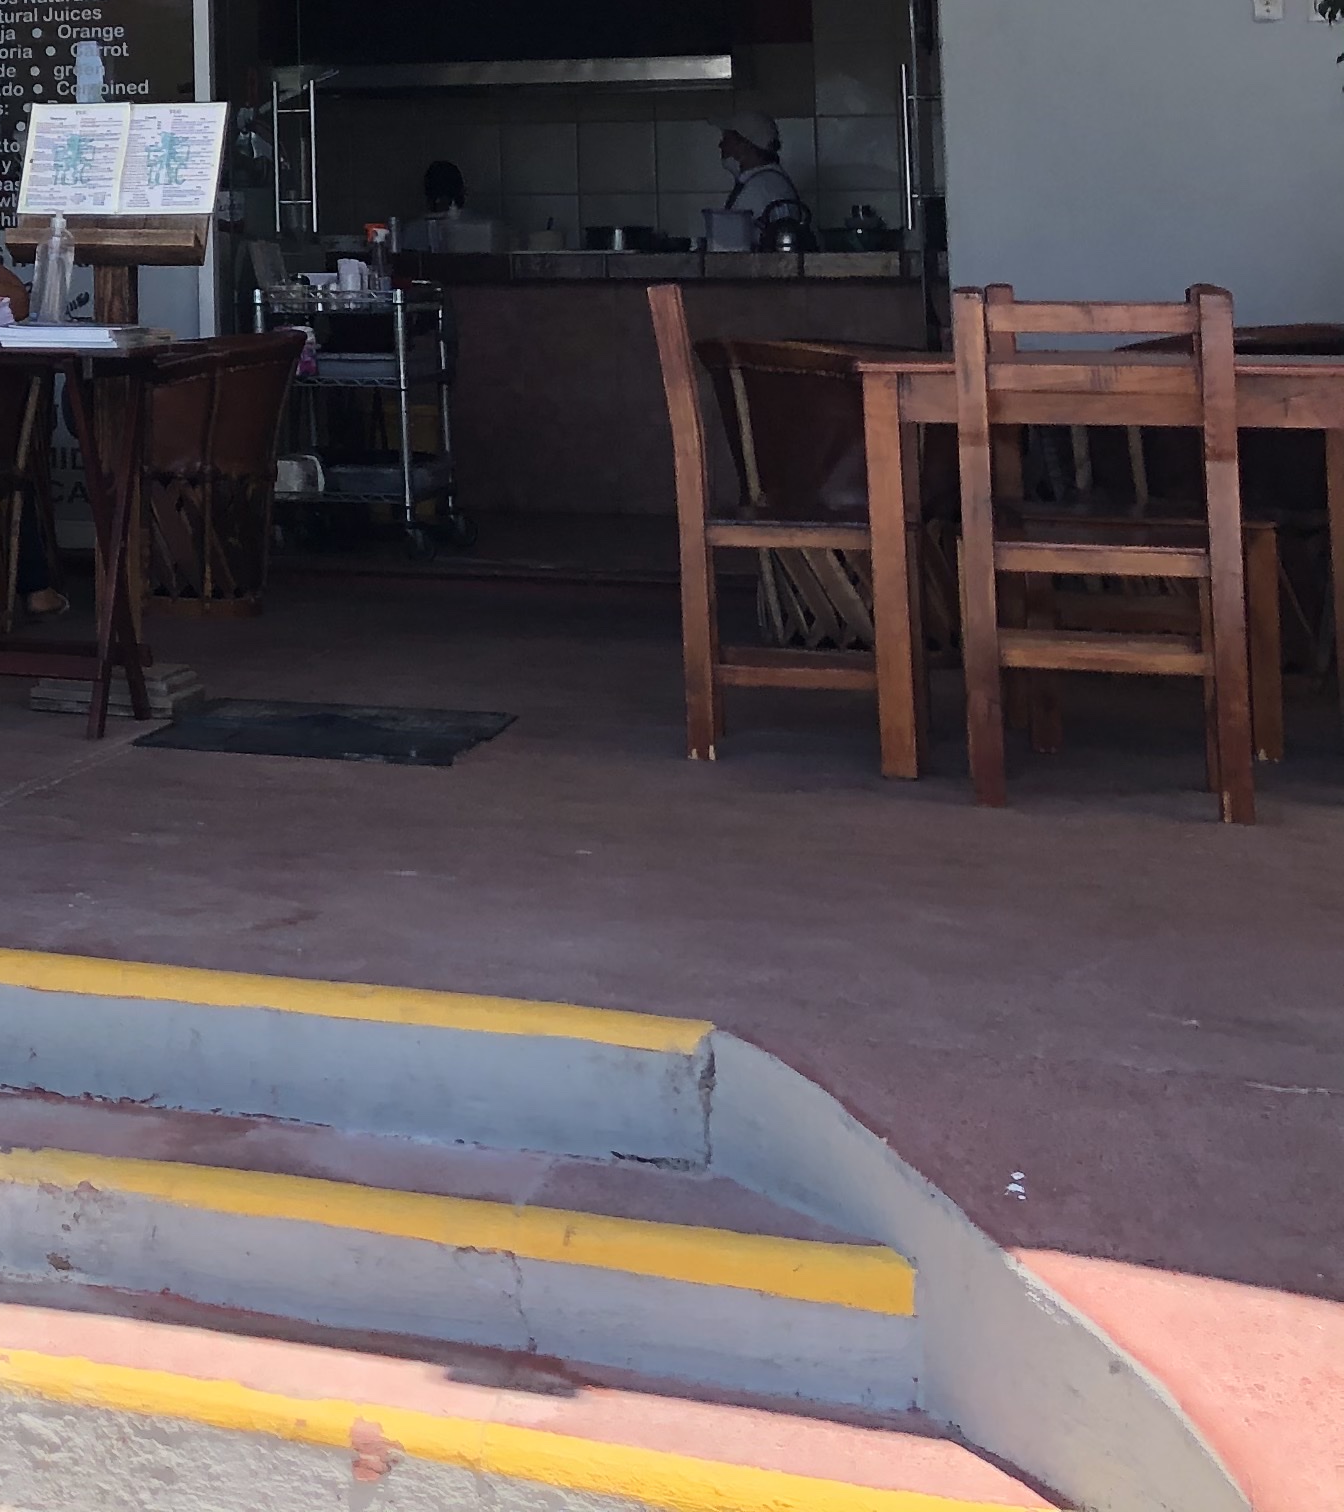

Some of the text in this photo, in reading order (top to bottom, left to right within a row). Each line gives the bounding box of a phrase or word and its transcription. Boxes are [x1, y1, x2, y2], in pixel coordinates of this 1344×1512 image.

[43, 7, 103, 23] Juices
[57, 25, 125, 41] Orange
[57, 79, 149, 96] Cobined
[2, 161, 12, 175] y
